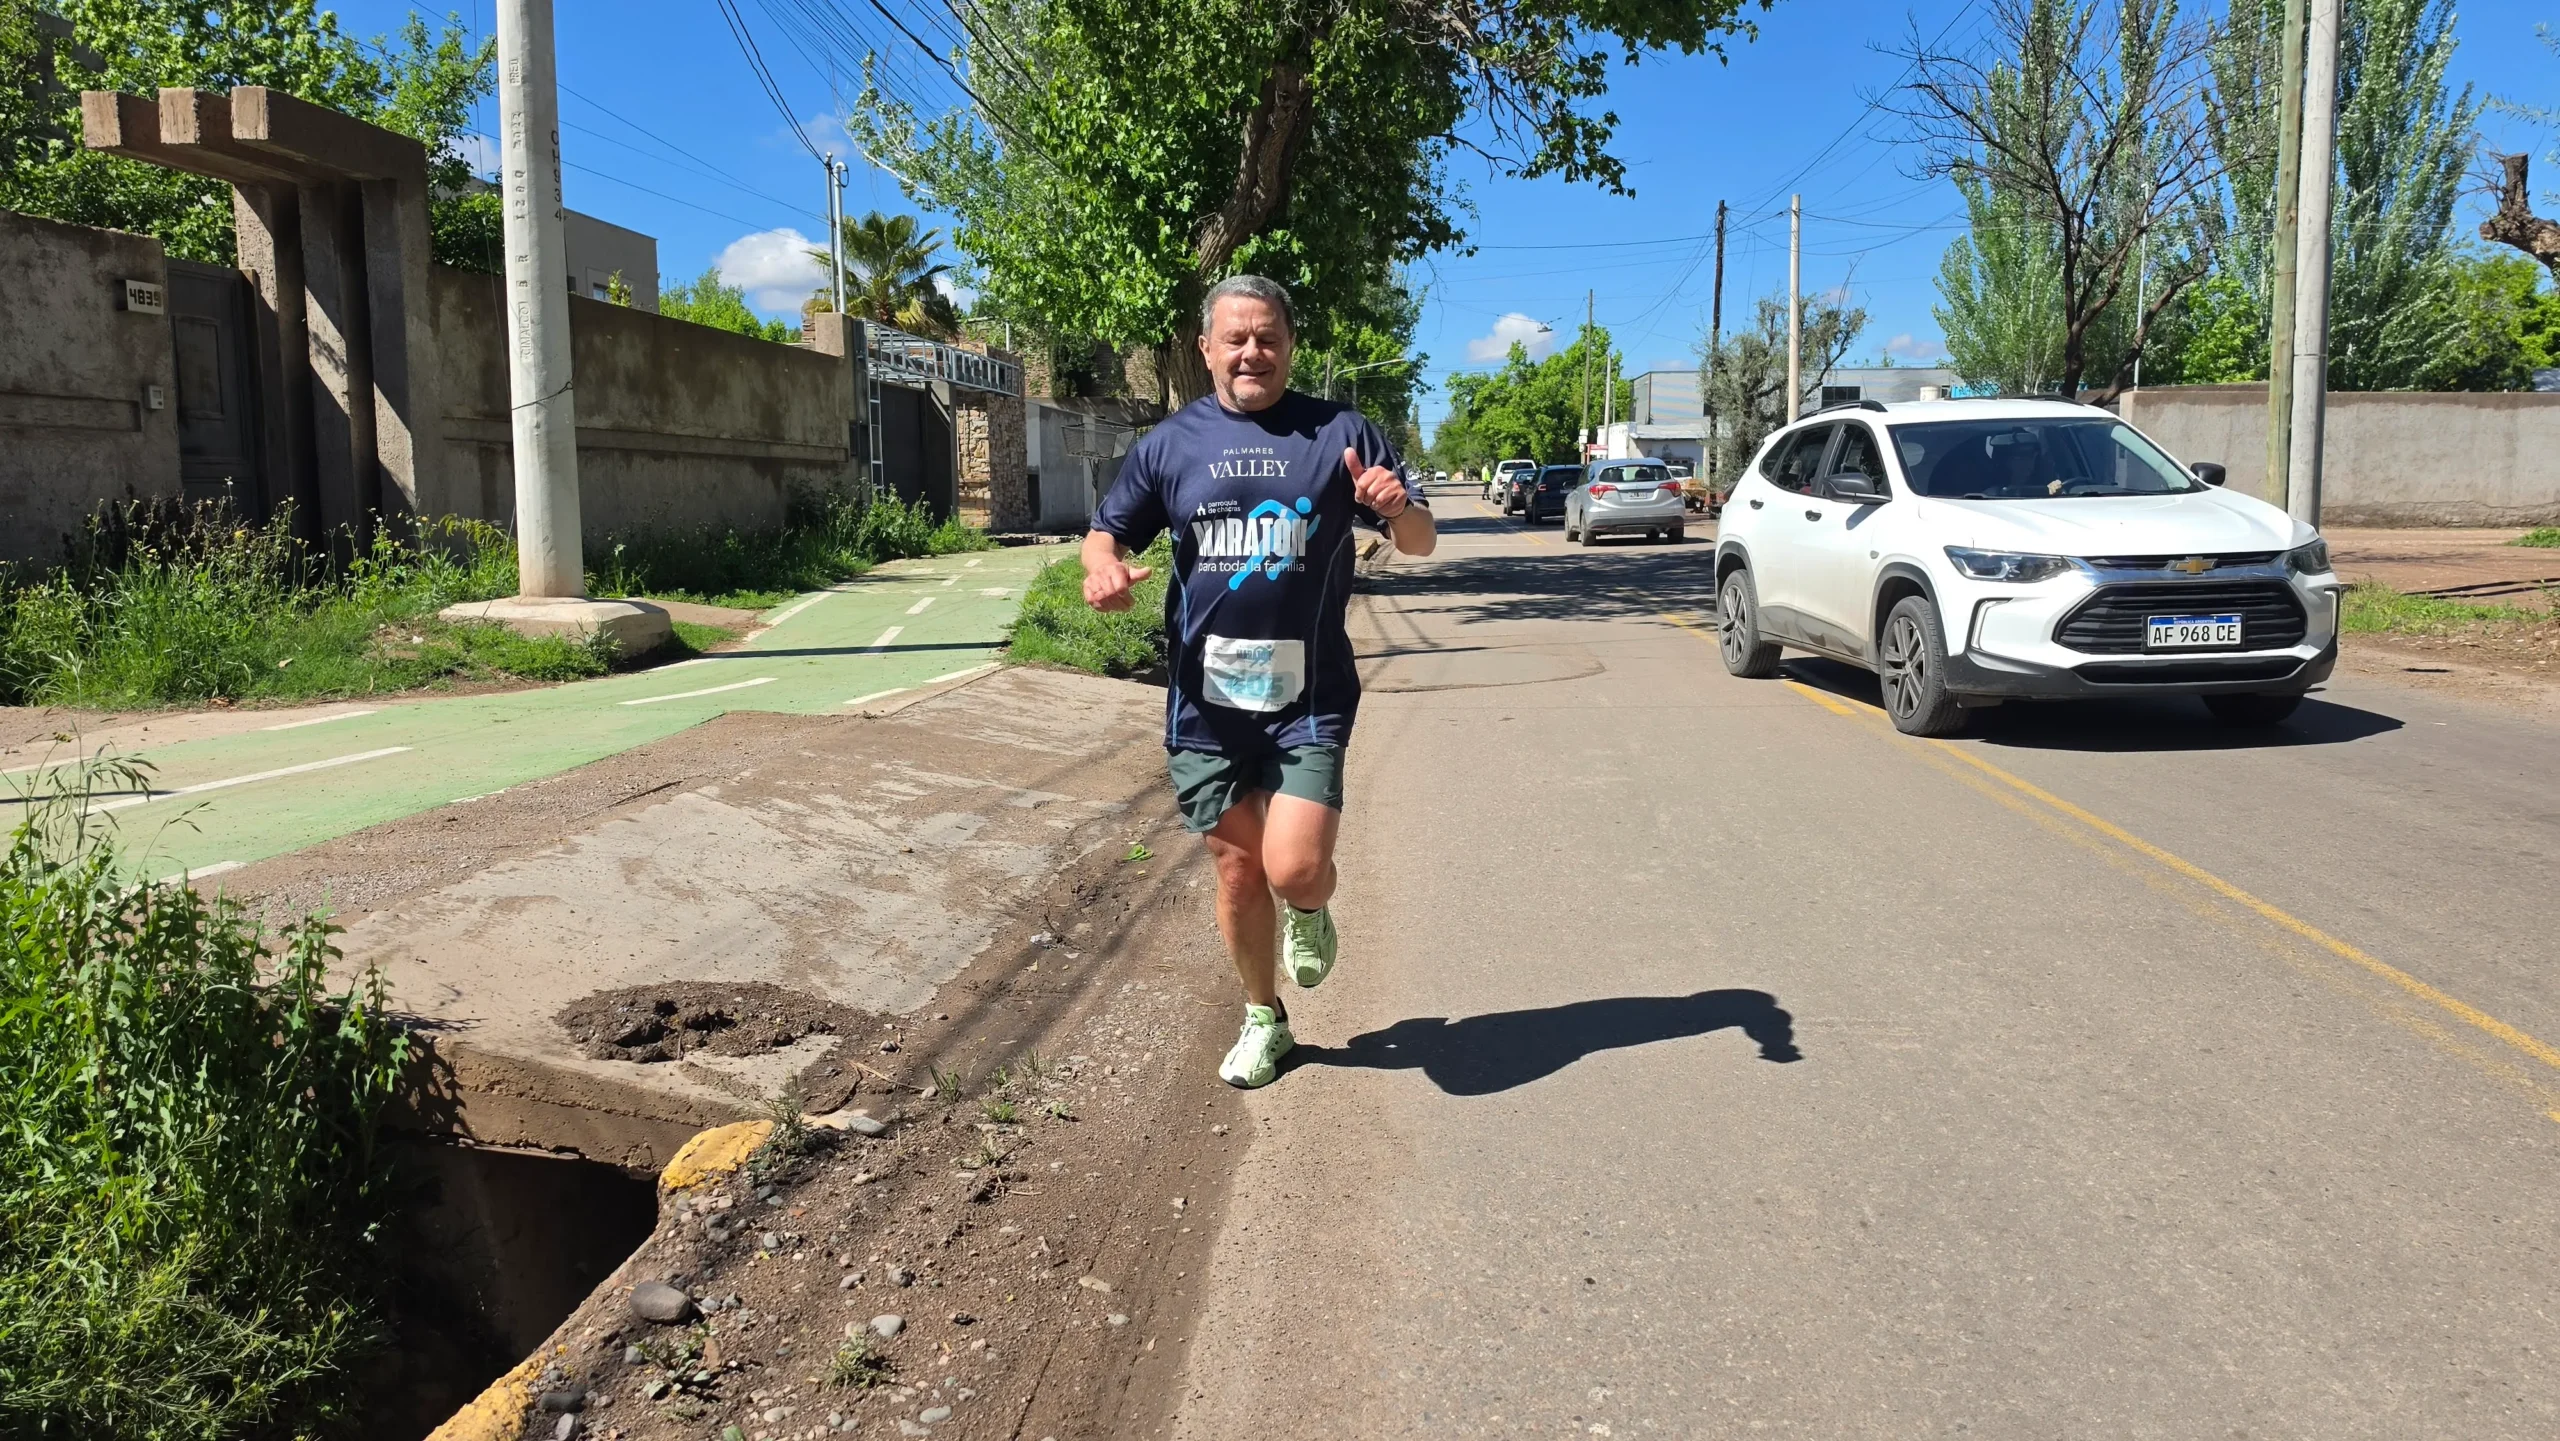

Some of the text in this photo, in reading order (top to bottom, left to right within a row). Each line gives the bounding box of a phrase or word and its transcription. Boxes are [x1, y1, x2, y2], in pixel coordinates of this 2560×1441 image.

[129, 287, 162, 308] 4839
[1223, 447, 1274, 457] PALMARES
[1208, 459, 1290, 479] VALLEY
[1207, 499, 1238, 509] parroquia
[1198, 560, 1306, 573] para toda la familia
[2153, 624, 2237, 644] AF 968 CE
